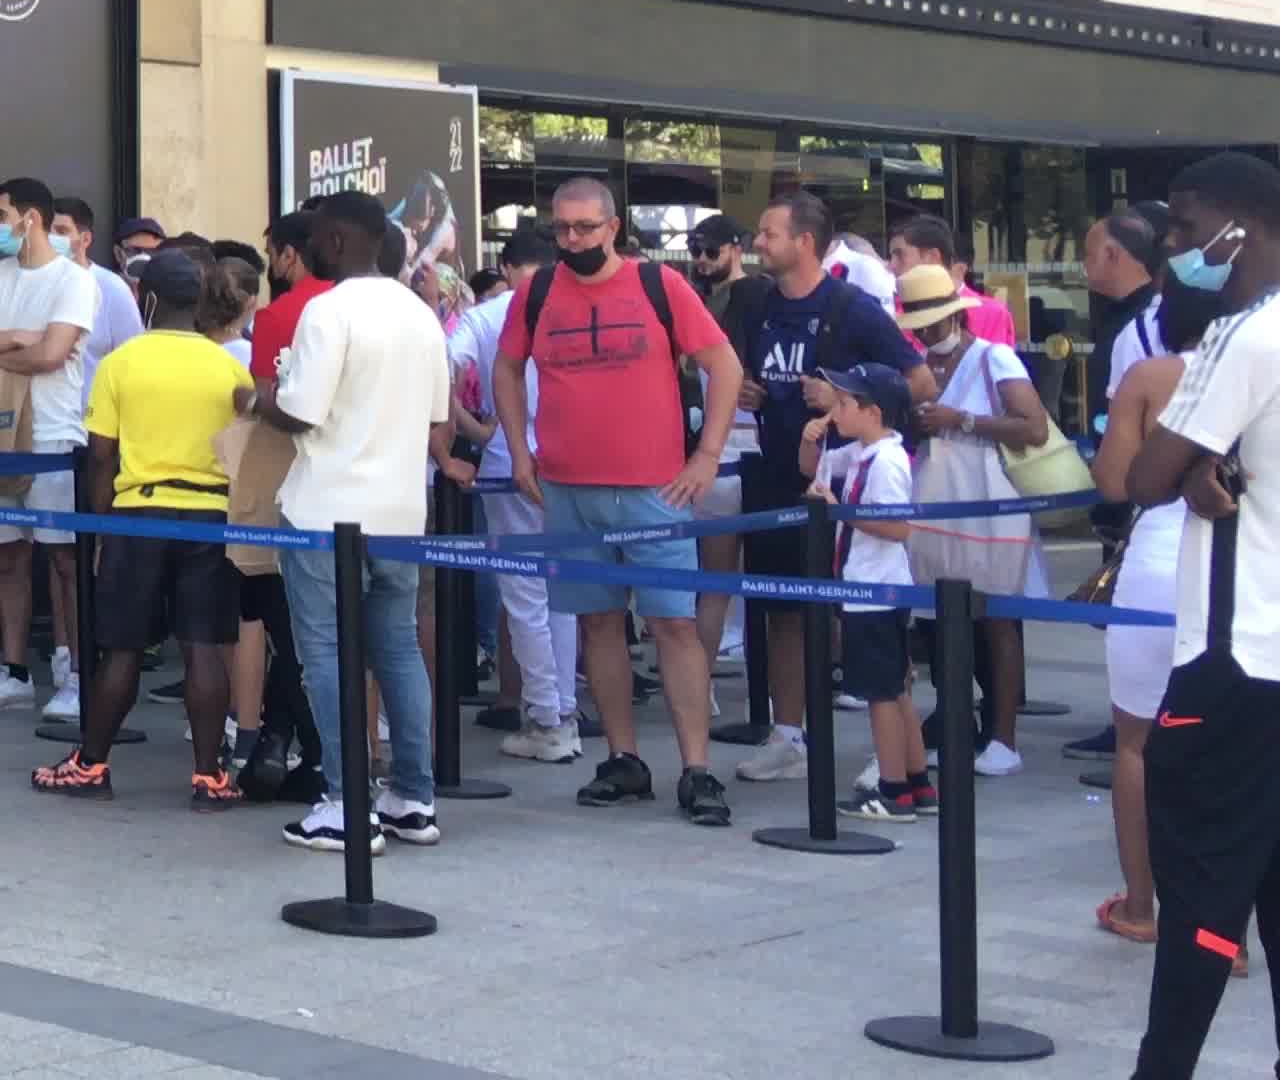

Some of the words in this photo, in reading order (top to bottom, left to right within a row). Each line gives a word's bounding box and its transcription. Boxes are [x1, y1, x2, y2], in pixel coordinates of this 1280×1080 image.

[309, 136, 373, 180] BALLET
[425, 551, 455, 564] PARIS
[457, 555, 538, 573] SAINT-GERMAIN
[741, 580, 777, 594] PARIS
[779, 584, 873, 600] SAINT-GERMAIN
